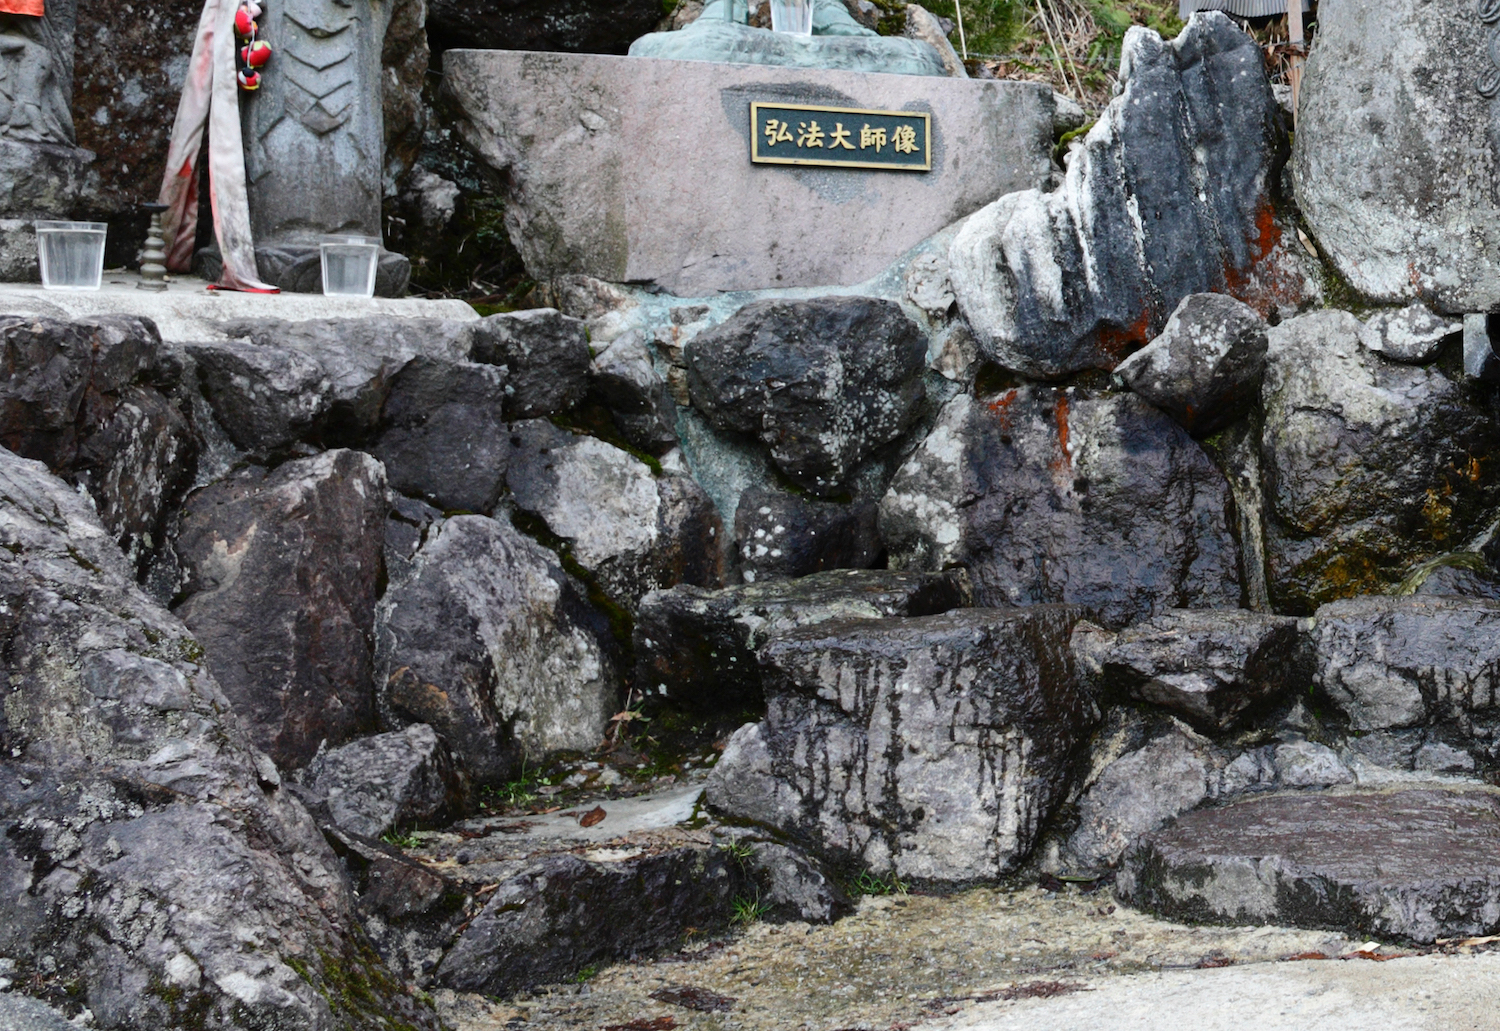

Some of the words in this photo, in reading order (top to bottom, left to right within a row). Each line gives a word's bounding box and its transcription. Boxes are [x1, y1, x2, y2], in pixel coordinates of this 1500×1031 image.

[763, 118, 921, 155] 弘法大師像
